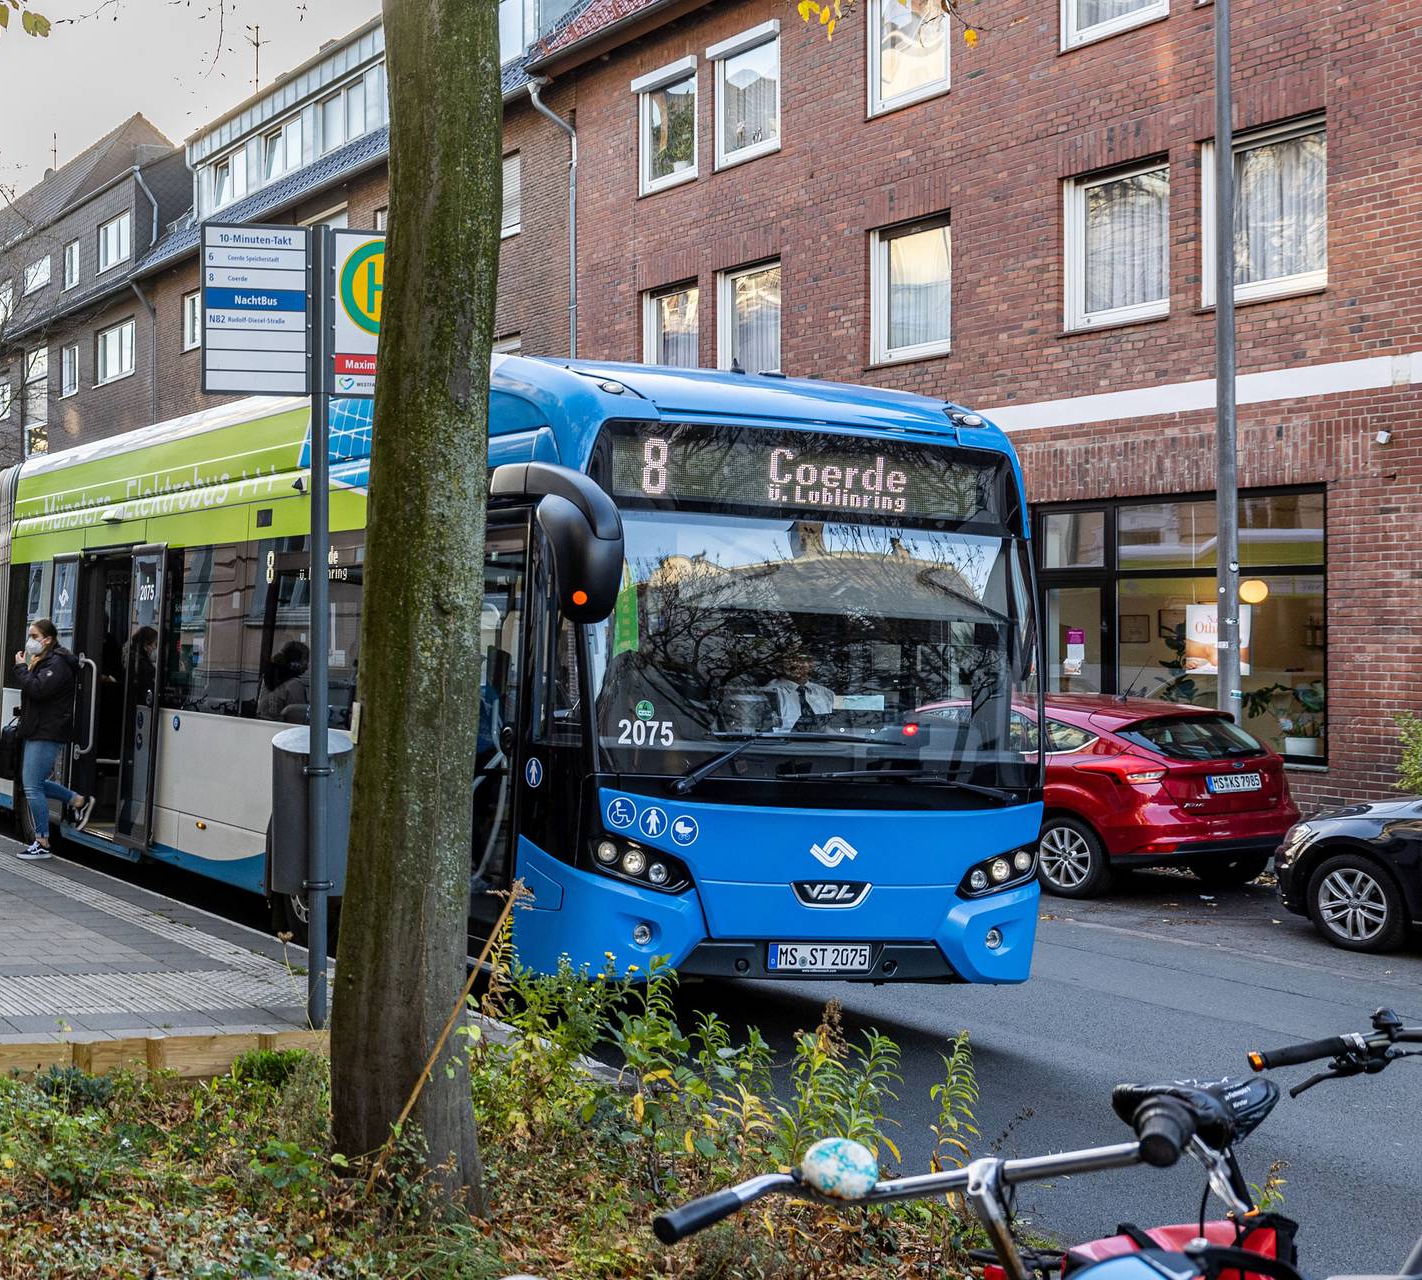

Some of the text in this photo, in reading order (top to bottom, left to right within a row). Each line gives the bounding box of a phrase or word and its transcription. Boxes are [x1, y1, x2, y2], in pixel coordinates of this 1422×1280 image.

[219, 234, 292, 246] 10-Minuten-Takt
[208, 252, 214, 261] 6
[208, 272, 215, 281] 8
[234, 295, 278, 306] NachtBus
[209, 314, 226, 323] N82
[345, 359, 376, 370] Maxim
[642, 438, 668, 494] 8
[769, 448, 908, 493] Coerde
[126, 466, 231, 518] Elektrobus
[266, 551, 275, 584] 8
[139, 584, 155, 601] 2075
[618, 719, 674, 746] 2075
[1230, 777, 1240, 788] KS
[1241, 775, 1260, 788] 7985
[803, 884, 855, 900] VDL
[779, 948, 798, 966] MS
[809, 948, 827, 966] ST
[831, 948, 868, 967] 2075
